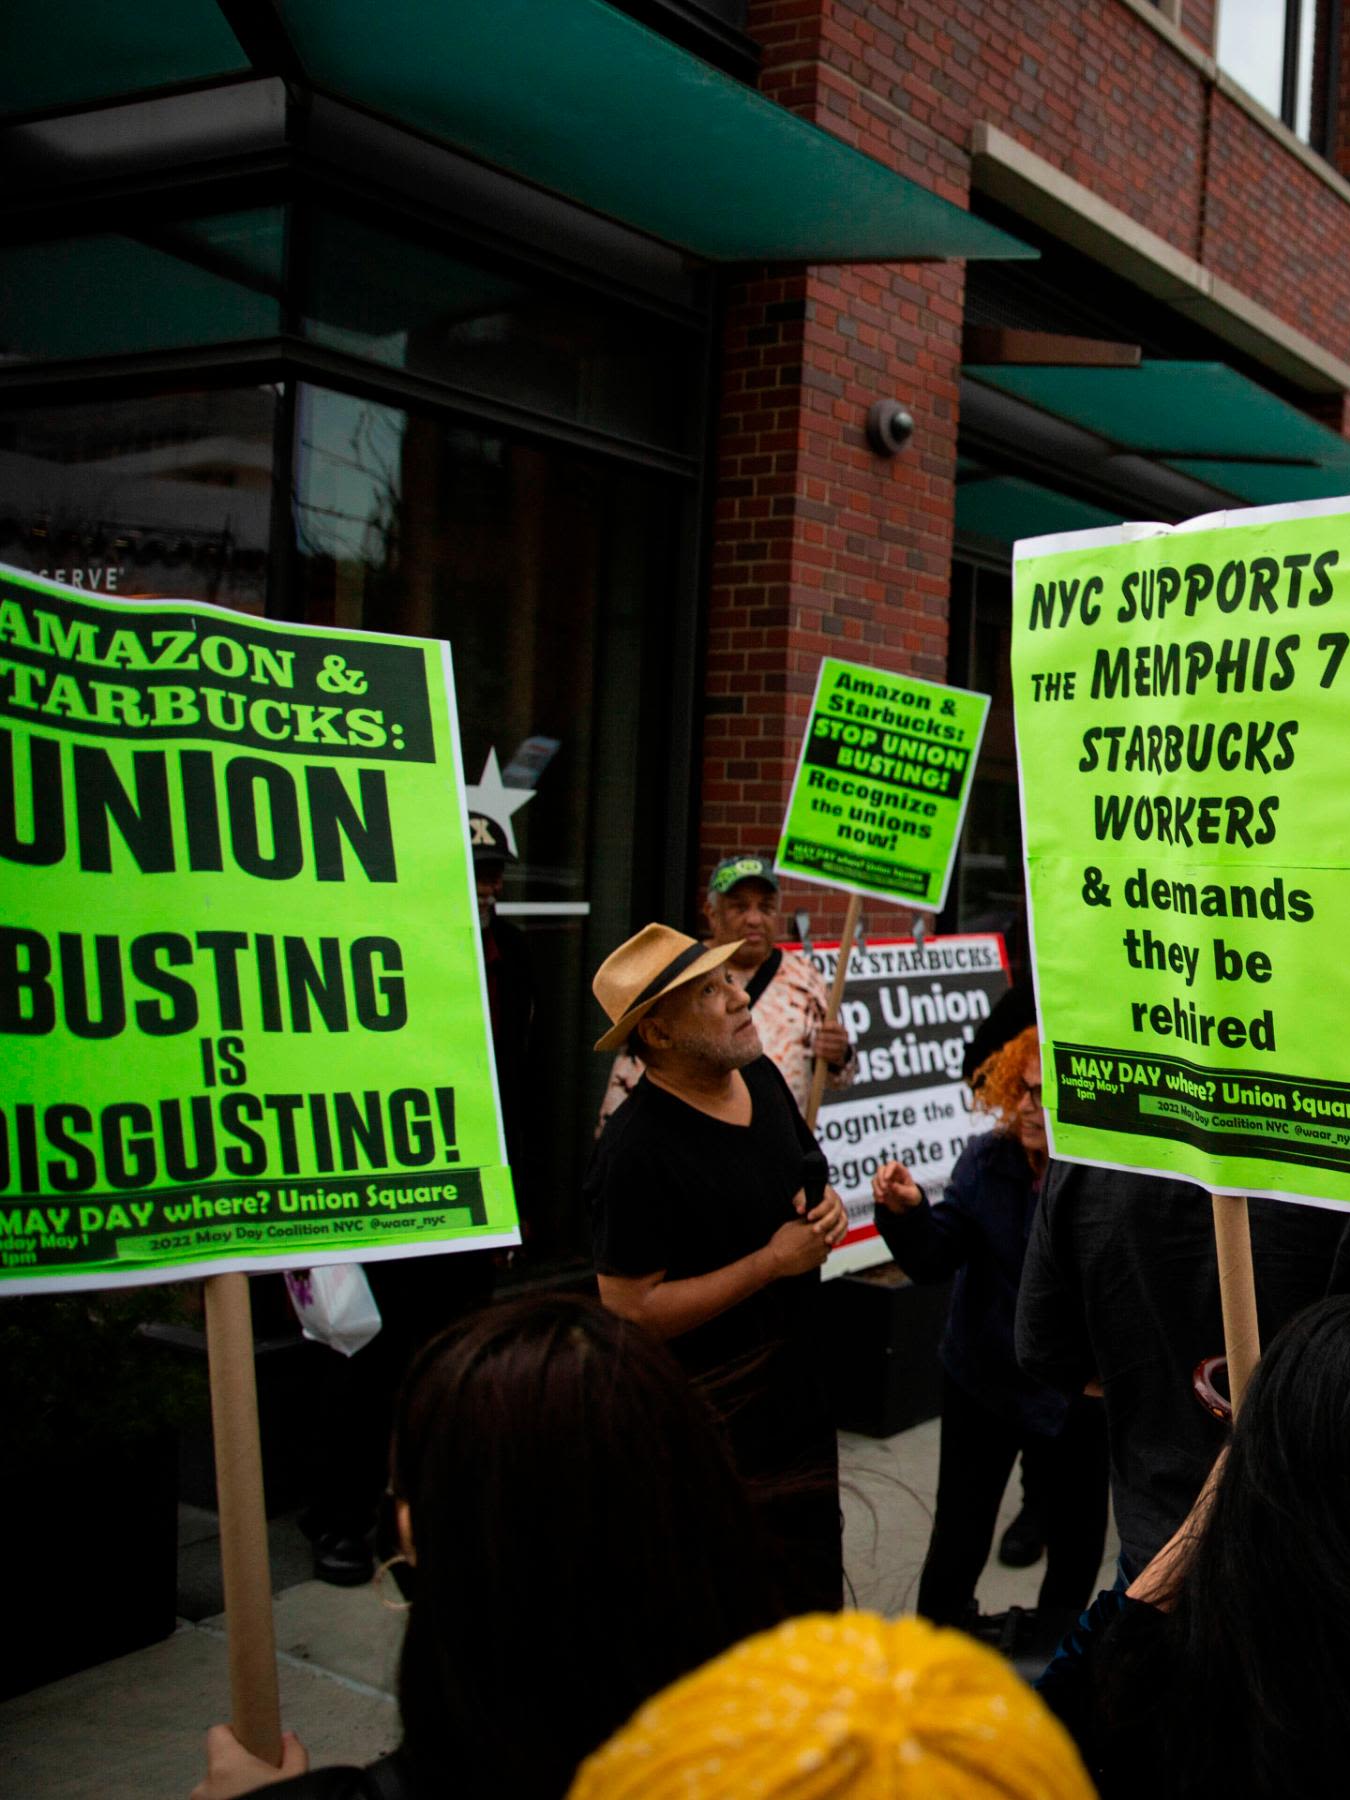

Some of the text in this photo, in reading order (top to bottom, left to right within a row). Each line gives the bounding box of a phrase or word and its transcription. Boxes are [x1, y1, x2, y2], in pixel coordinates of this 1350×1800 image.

[1029, 550, 1339, 631] NYC SUPPORTS
[0, 598, 368, 695] AMAZON &
[1031, 632, 1350, 702] THE MEMPHIS 7
[0, 658, 406, 750] TARBUCKS:
[828, 693, 965, 743] Starbucks:
[834, 671, 957, 717] Amazon &
[813, 717, 965, 772] STOP UNION
[837, 746, 950, 792] BUSTING!
[1079, 720, 1299, 775] STARBUCKS
[0, 729, 398, 883] UNION
[807, 769, 938, 818] Recognize
[810, 797, 932, 839] the unions
[837, 822, 899, 851] now!
[1094, 795, 1279, 848] WORKERS
[1082, 866, 1315, 922] & demands
[0, 925, 408, 1040] BUSTING
[1123, 929, 1272, 986] they be
[878, 983, 990, 1029] Union
[1131, 997, 1276, 1051] rehired
[203, 1036, 247, 1088] IS
[1061, 1074, 1095, 1090] Sunday
[1096, 1078, 1118, 1094] May
[1070, 1056, 1113, 1080] MAY
[1118, 1062, 1161, 1087] DAY
[1166, 1072, 1216, 1102] where?
[1222, 1082, 1287, 1110] Union
[924, 1101, 954, 1122] the
[1157, 1101, 1179, 1114] 2022
[1211, 1115, 1263, 1131] Coalition
[1266, 1120, 1290, 1134] NYC
[0, 1086, 460, 1195] ISGUSTING!
[0, 1183, 458, 1235] MAY DAY where? Union Square
[150, 1235, 191, 1250] 2022
[196, 1230, 232, 1245] May
[236, 1226, 263, 1241] Day
[267, 1221, 329, 1238] Coalition
[334, 1220, 363, 1233] NYC
